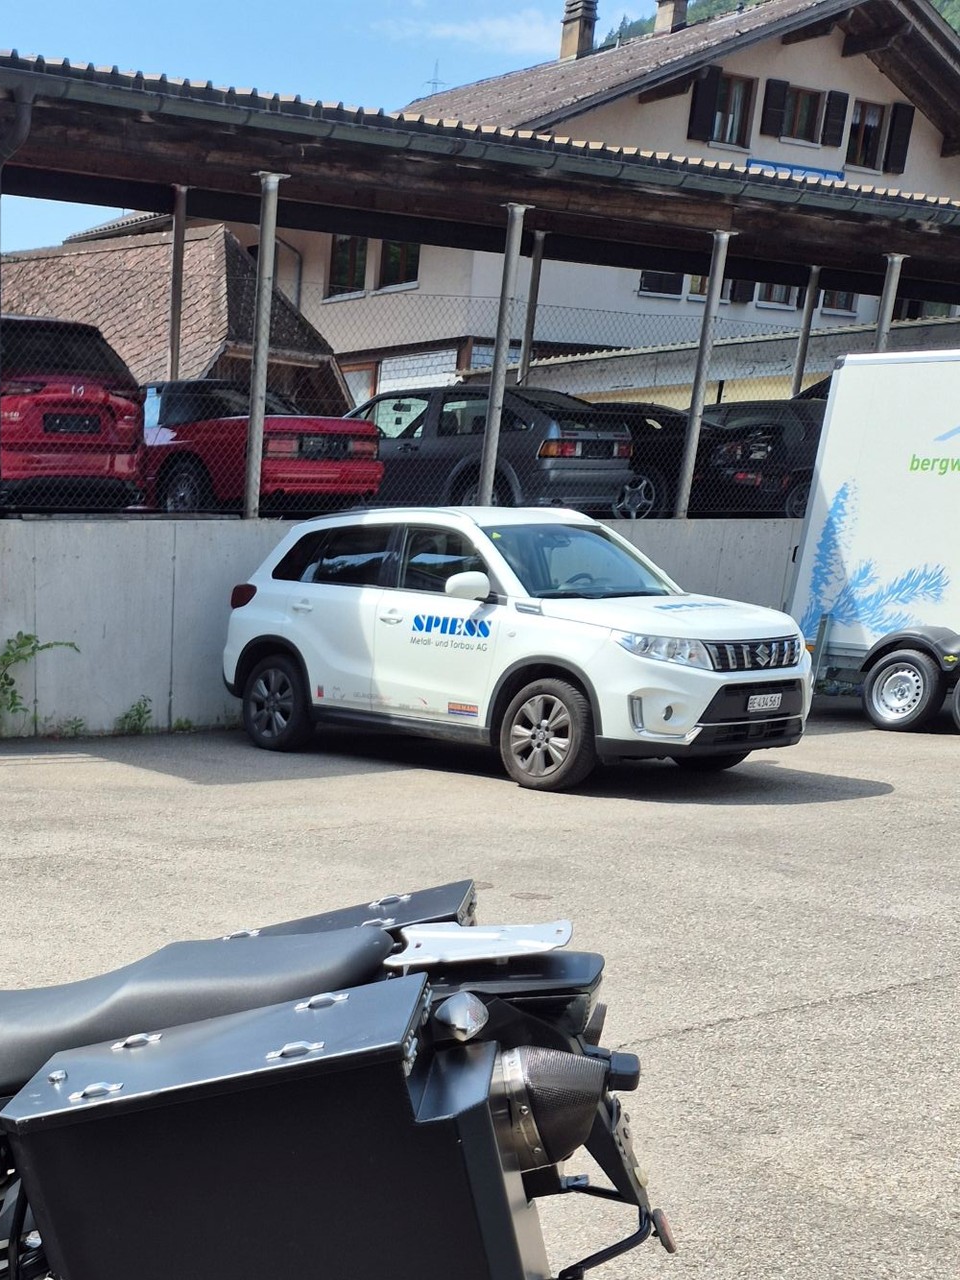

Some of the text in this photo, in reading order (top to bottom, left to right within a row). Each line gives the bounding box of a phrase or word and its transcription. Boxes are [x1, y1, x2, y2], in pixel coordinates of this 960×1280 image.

[412, 614, 492, 638] SPIESS
[435, 639, 449, 648] und
[450, 640, 474, 651] Torbau
[476, 643, 488, 652] AG
